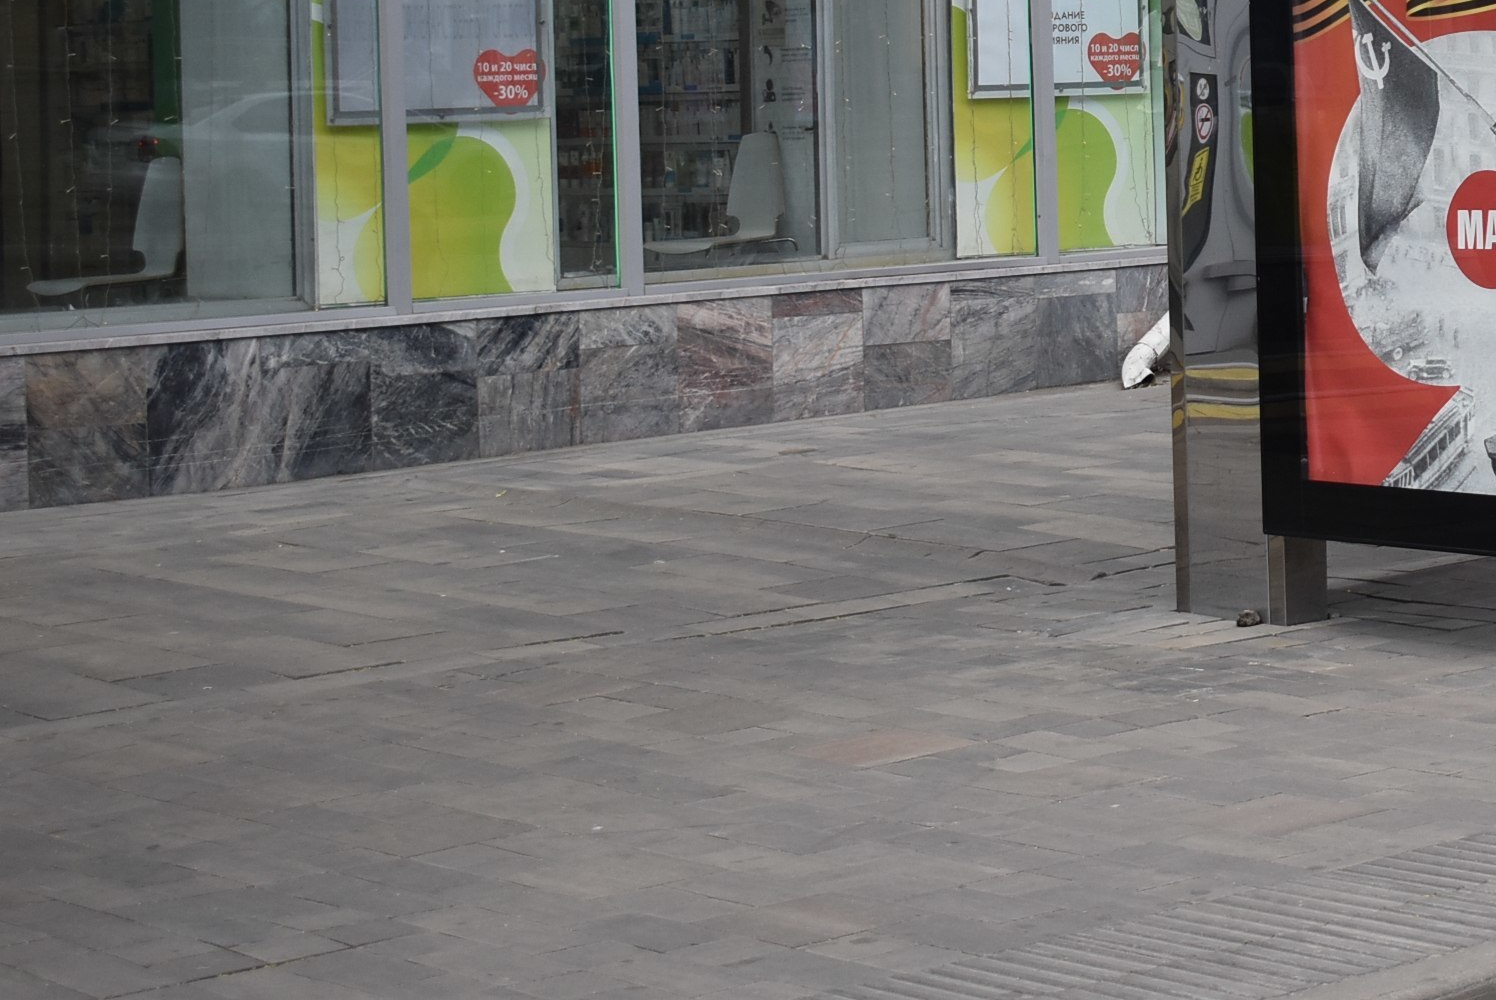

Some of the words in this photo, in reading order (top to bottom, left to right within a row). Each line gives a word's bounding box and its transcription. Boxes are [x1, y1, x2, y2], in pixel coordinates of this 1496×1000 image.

[1053, 23, 1088, 33] РОВОГО
[1090, 44, 1100, 52] 10
[1108, 43, 1118, 52] 20
[1120, 44, 1139, 52] числ
[477, 62, 489, 72] 10
[499, 61, 512, 72] 20
[513, 62, 537, 72] числ
[1103, 64, 1132, 77] -30%
[513, 73, 538, 81] месяц
[493, 85, 528, 99] -30%
